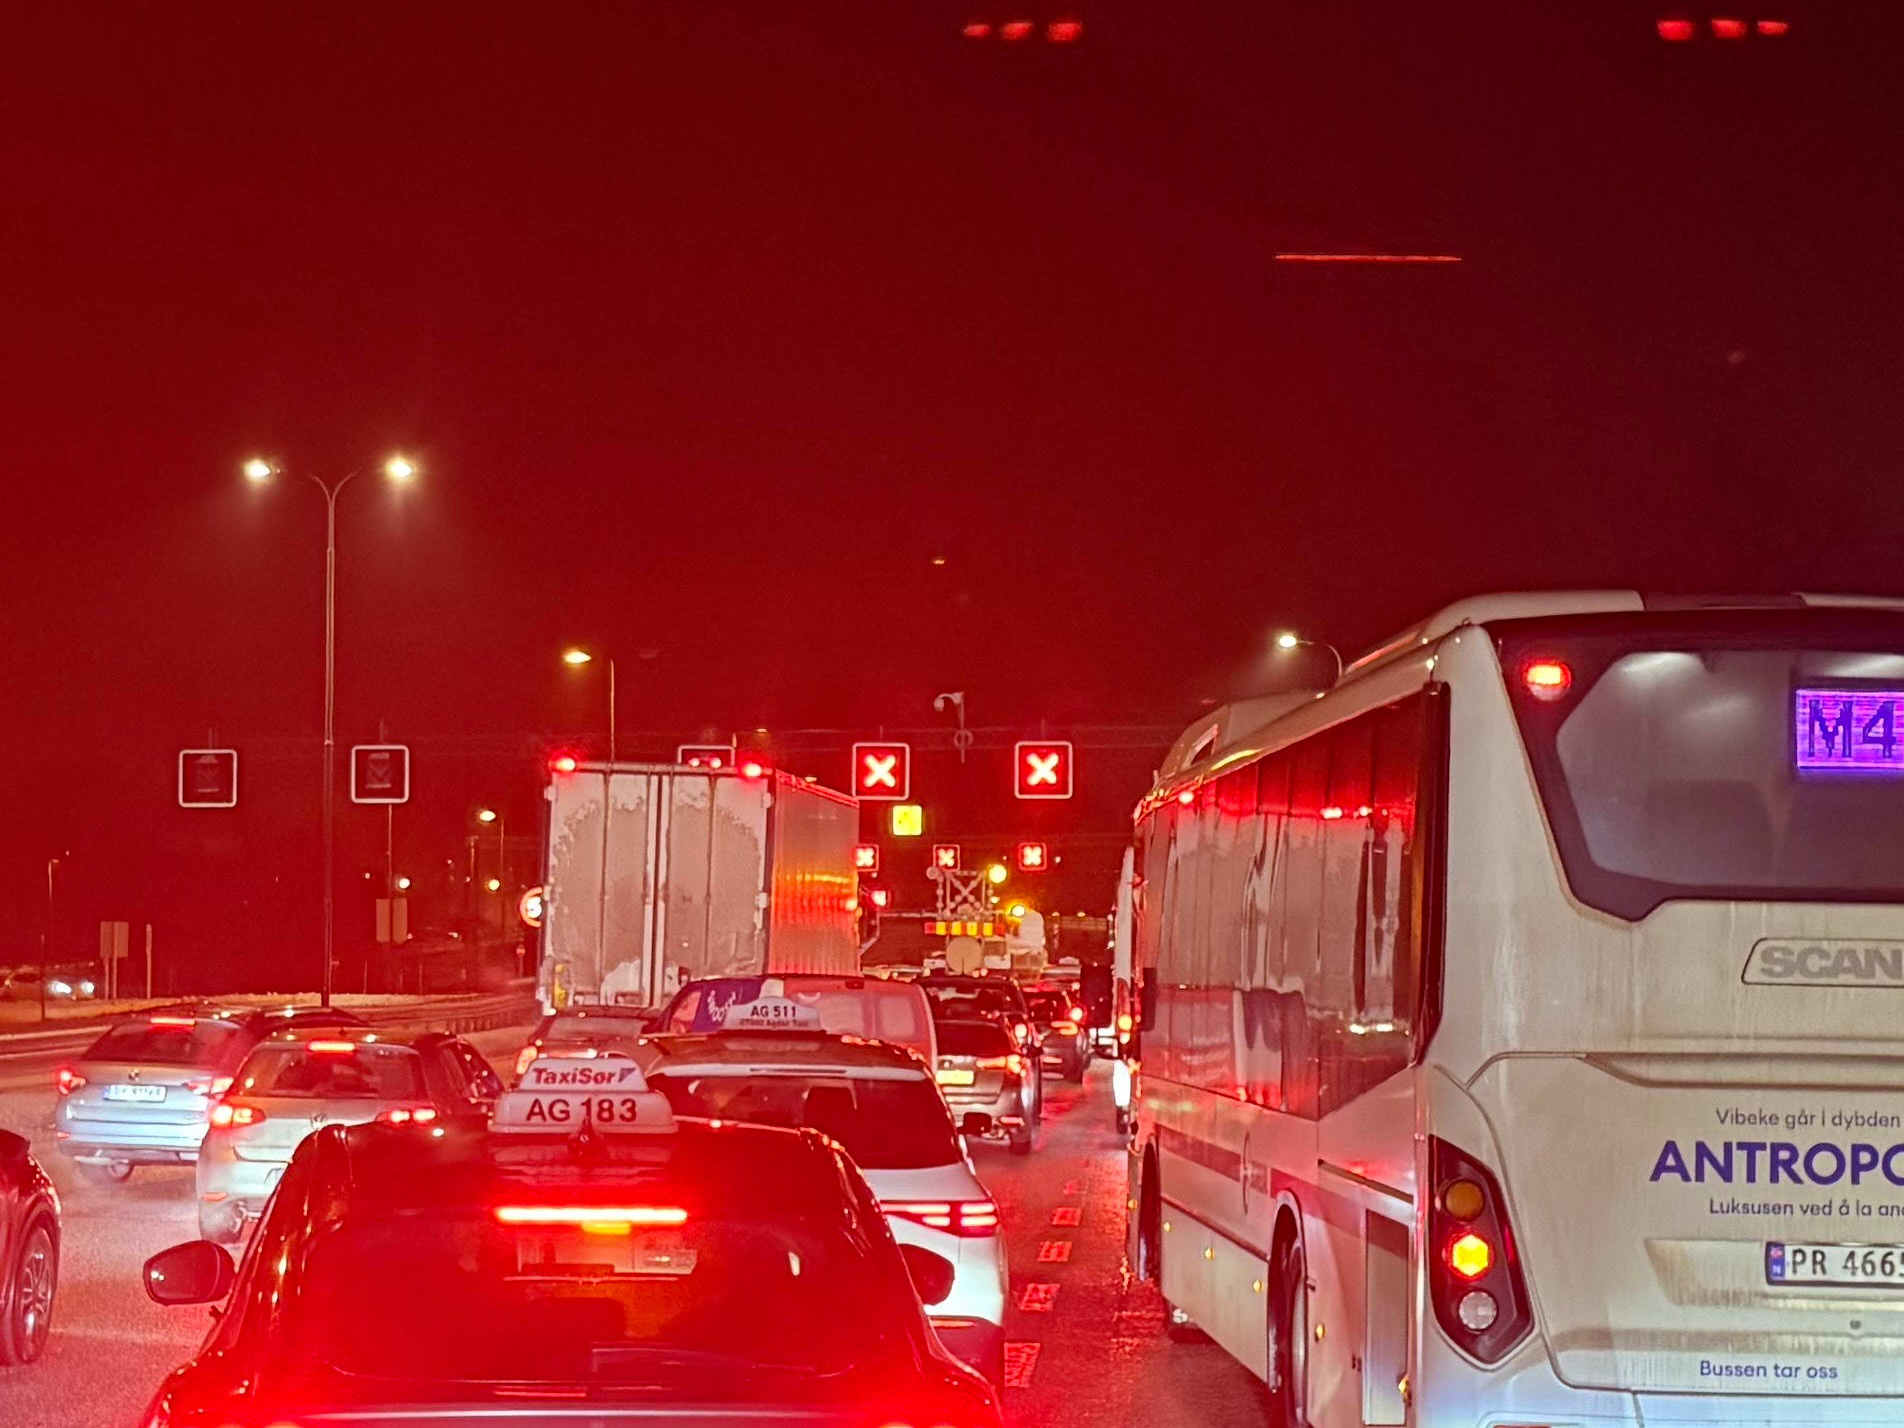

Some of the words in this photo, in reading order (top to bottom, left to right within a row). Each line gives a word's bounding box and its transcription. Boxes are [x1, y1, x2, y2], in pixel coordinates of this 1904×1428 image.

[1808, 699, 1897, 759] M4
[750, 1005, 769, 1018] AG
[773, 1005, 796, 1018] 511
[526, 1098, 571, 1122] AG
[580, 1098, 637, 1122] 183
[1716, 1107, 1779, 1126] Vibeke
[1785, 1108, 1816, 1131] går
[1831, 1110, 1900, 1132] dybden
[1709, 1197, 1794, 1216] Luksusen
[1799, 1198, 1833, 1217] ved
[1838, 1198, 1851, 1217] å
[1856, 1199, 1873, 1218] la
[1791, 1248, 1827, 1276] PR
[1699, 1359, 1767, 1378] Bussen
[1773, 1361, 1801, 1379] tar
[1806, 1365, 1838, 1379] oss
